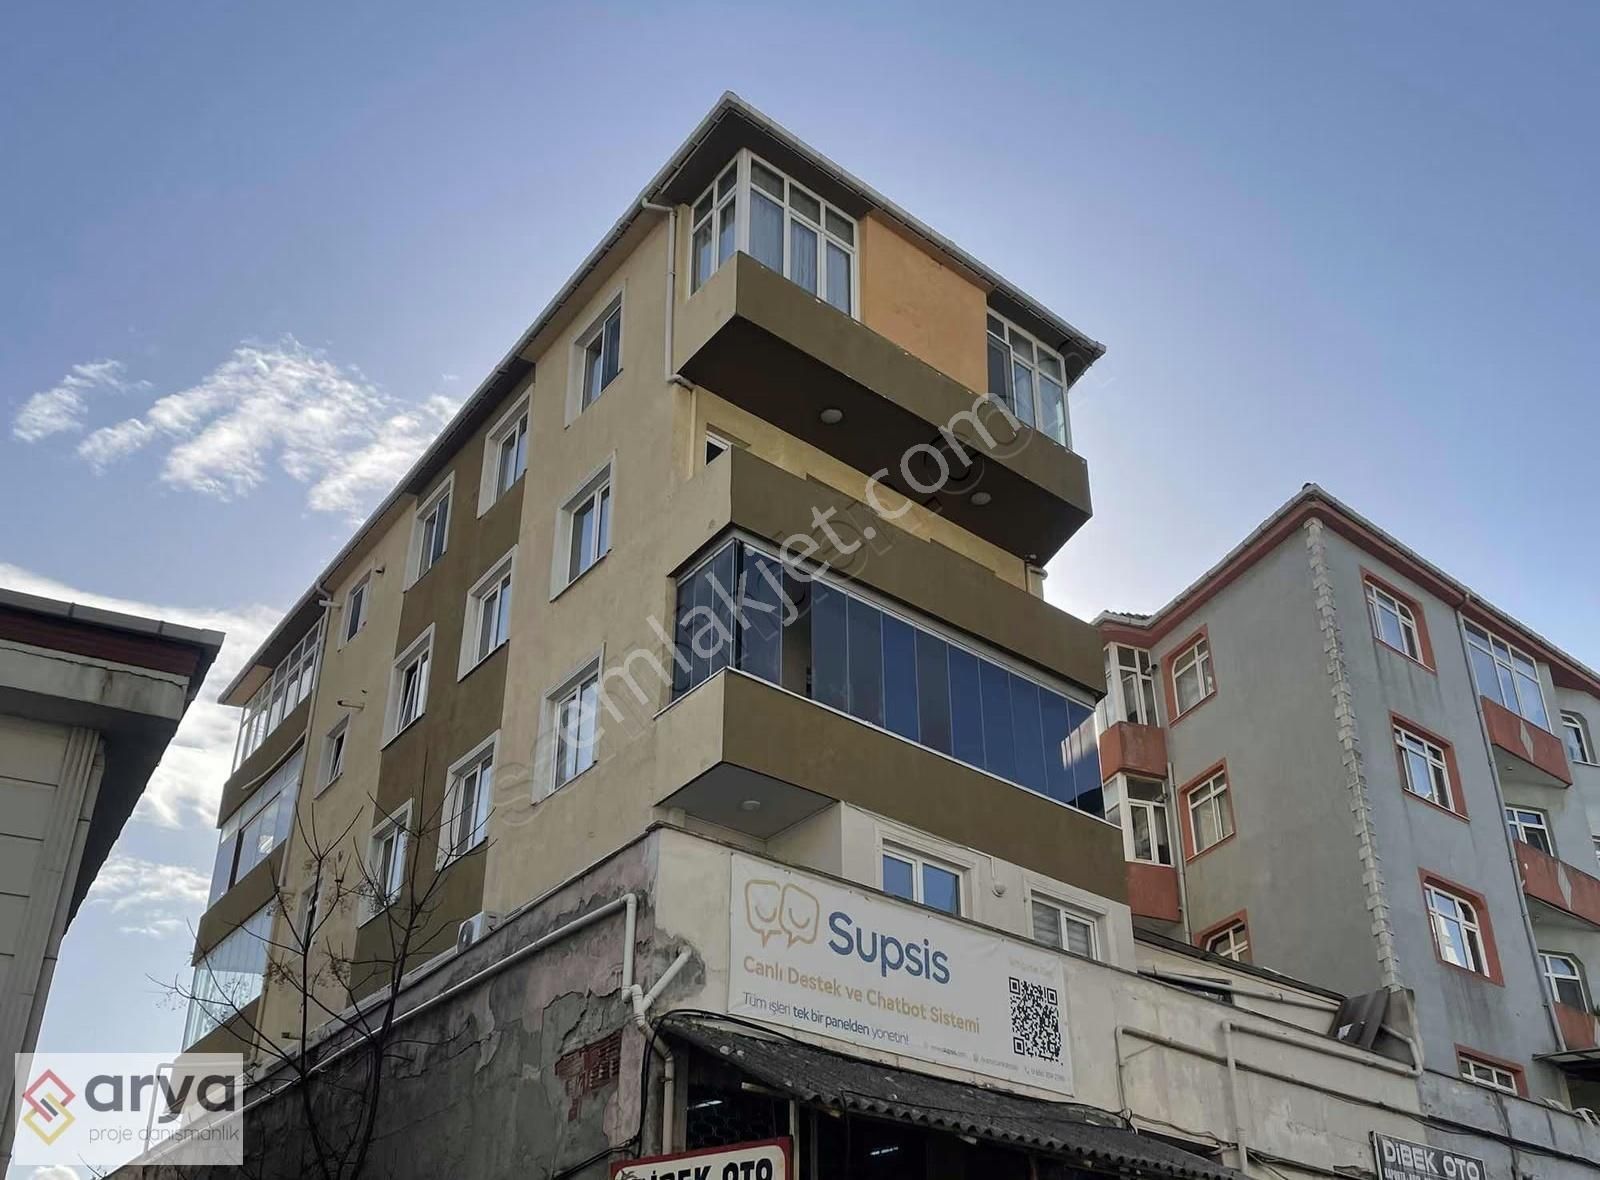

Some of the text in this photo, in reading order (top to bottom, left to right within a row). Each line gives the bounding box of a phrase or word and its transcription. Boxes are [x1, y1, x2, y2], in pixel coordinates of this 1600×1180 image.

[828, 911, 950, 984] Supsis
[743, 955, 980, 1034] Canlı Destek ve Chatbot Sistemi
[743, 992, 767, 1010] Tüm
[793, 1005, 810, 1021] tek
[811, 1009, 823, 1024] bir
[825, 1016, 870, 1036] panelden
[723, 1158, 773, 1180] OTO
[1443, 1155, 1480, 1180] OTO
